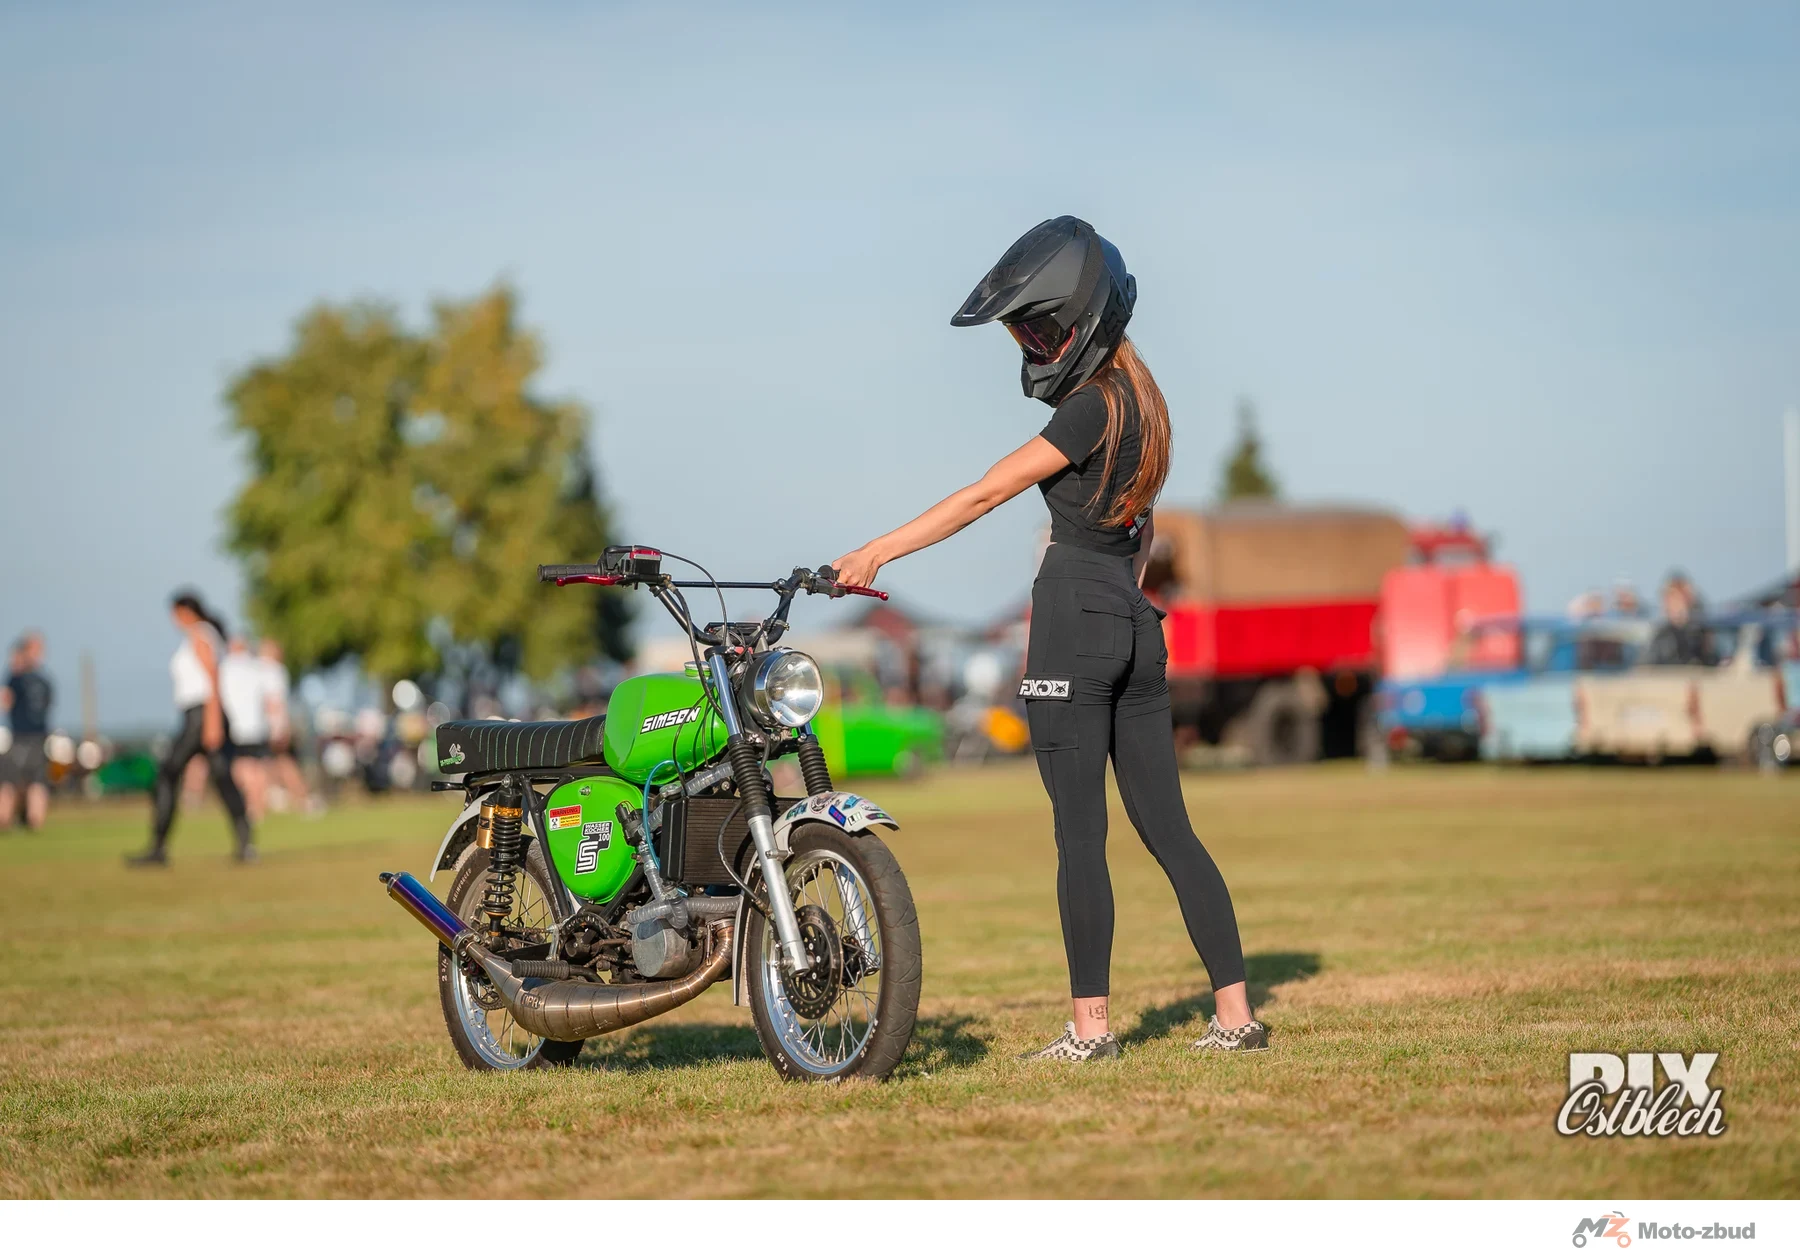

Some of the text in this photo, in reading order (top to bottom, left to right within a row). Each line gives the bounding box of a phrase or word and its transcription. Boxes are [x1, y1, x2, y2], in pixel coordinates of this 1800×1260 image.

[640, 706, 701, 734] SIMSON
[598, 833, 610, 842] 100
[1088, 1004, 1108, 1020] 19
